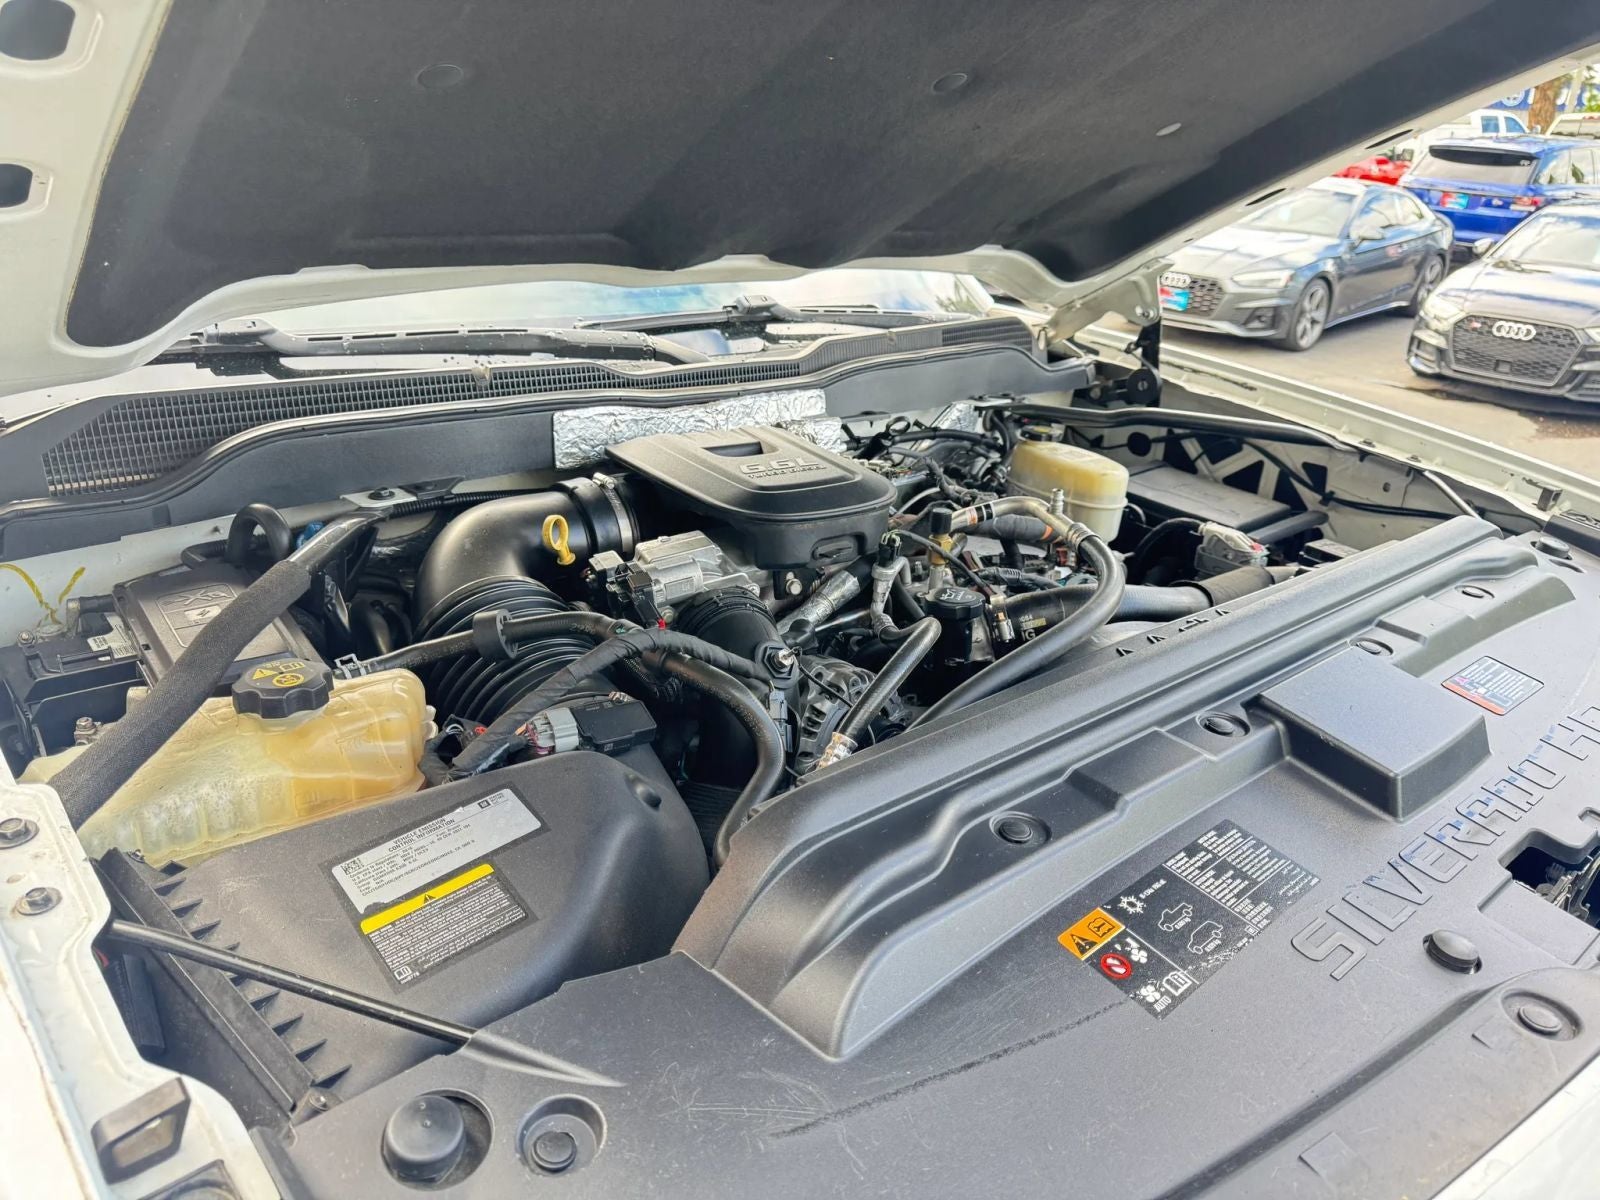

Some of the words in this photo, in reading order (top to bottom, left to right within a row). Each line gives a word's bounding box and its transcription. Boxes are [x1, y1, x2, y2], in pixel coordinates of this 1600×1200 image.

[739, 457, 820, 475] 6.6L
[388, 838, 414, 853] CONTROL
[416, 819, 455, 840] INFORMATION
[393, 831, 416, 845] VEHICLE
[418, 818, 446, 833] EMISSION
[1291, 748, 1567, 981] SILVERADO
[1153, 995, 1172, 1012] AUTO
